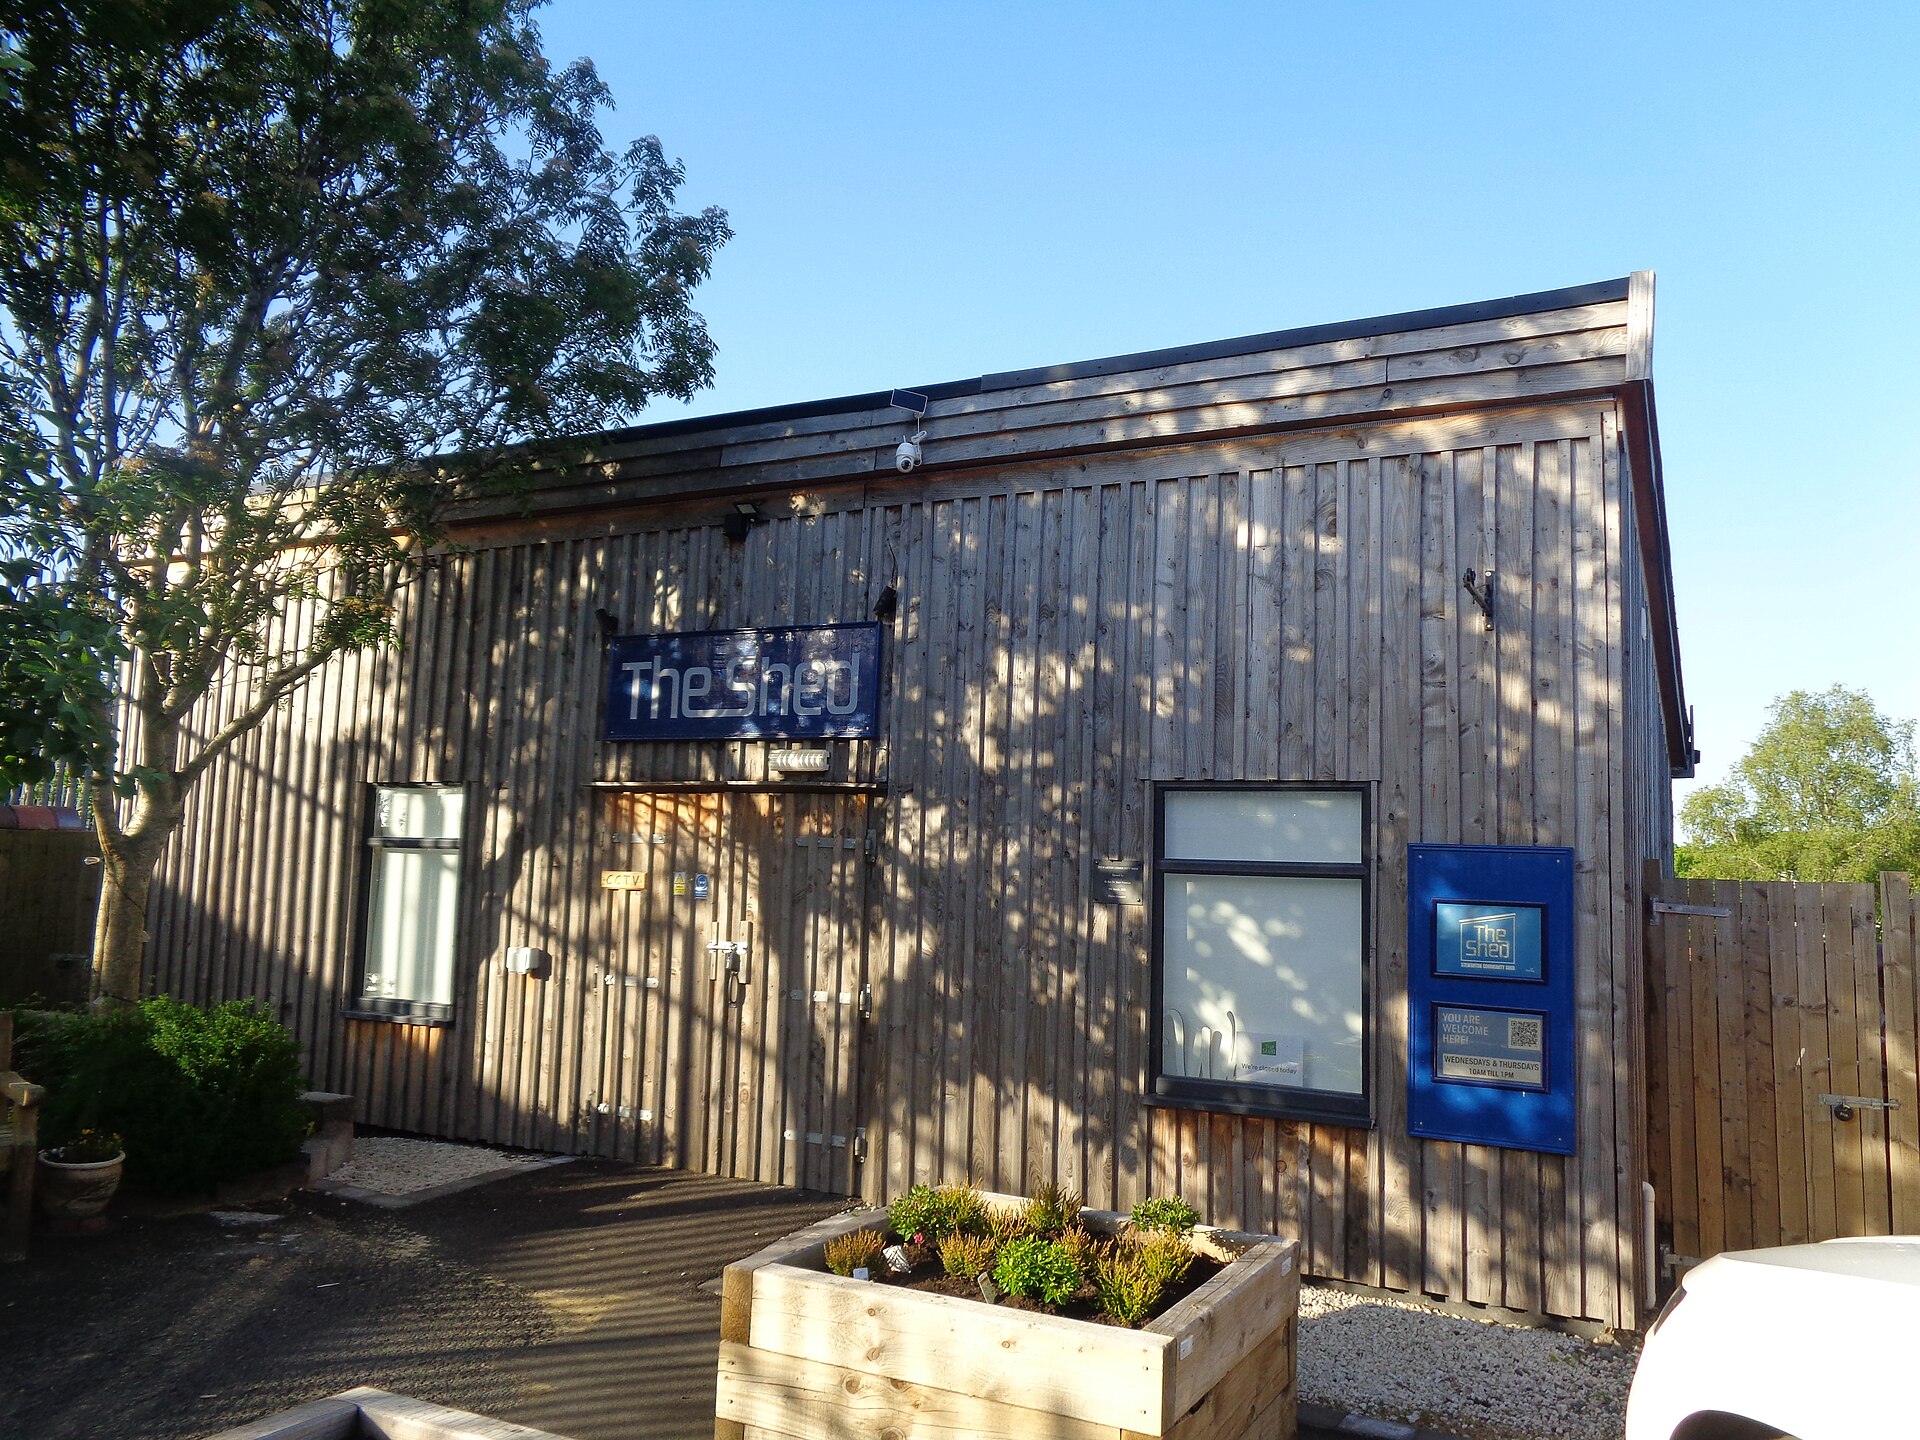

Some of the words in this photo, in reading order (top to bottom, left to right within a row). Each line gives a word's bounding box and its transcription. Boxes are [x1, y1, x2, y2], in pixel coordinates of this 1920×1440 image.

[622, 655, 712, 720] The
[724, 652, 860, 719] Shed
[606, 874, 640, 886] CCTV
[1474, 924, 1507, 943] The
[1465, 940, 1510, 958] Shed
[1442, 1012, 1461, 1023] YOU
[1462, 1015, 1481, 1025] ARE
[1442, 1023, 1489, 1036] WELCOME
[1442, 1034, 1469, 1045] HERE!
[1241, 1063, 1258, 1071] We're
[1280, 1067, 1298, 1075] today
[1444, 1055, 1491, 1067] WEDNESDAYS
[1499, 1060, 1540, 1071] THURSDAYS
[1487, 1070, 1499, 1078] TILL
[1501, 1071, 1515, 1079] 1PM
